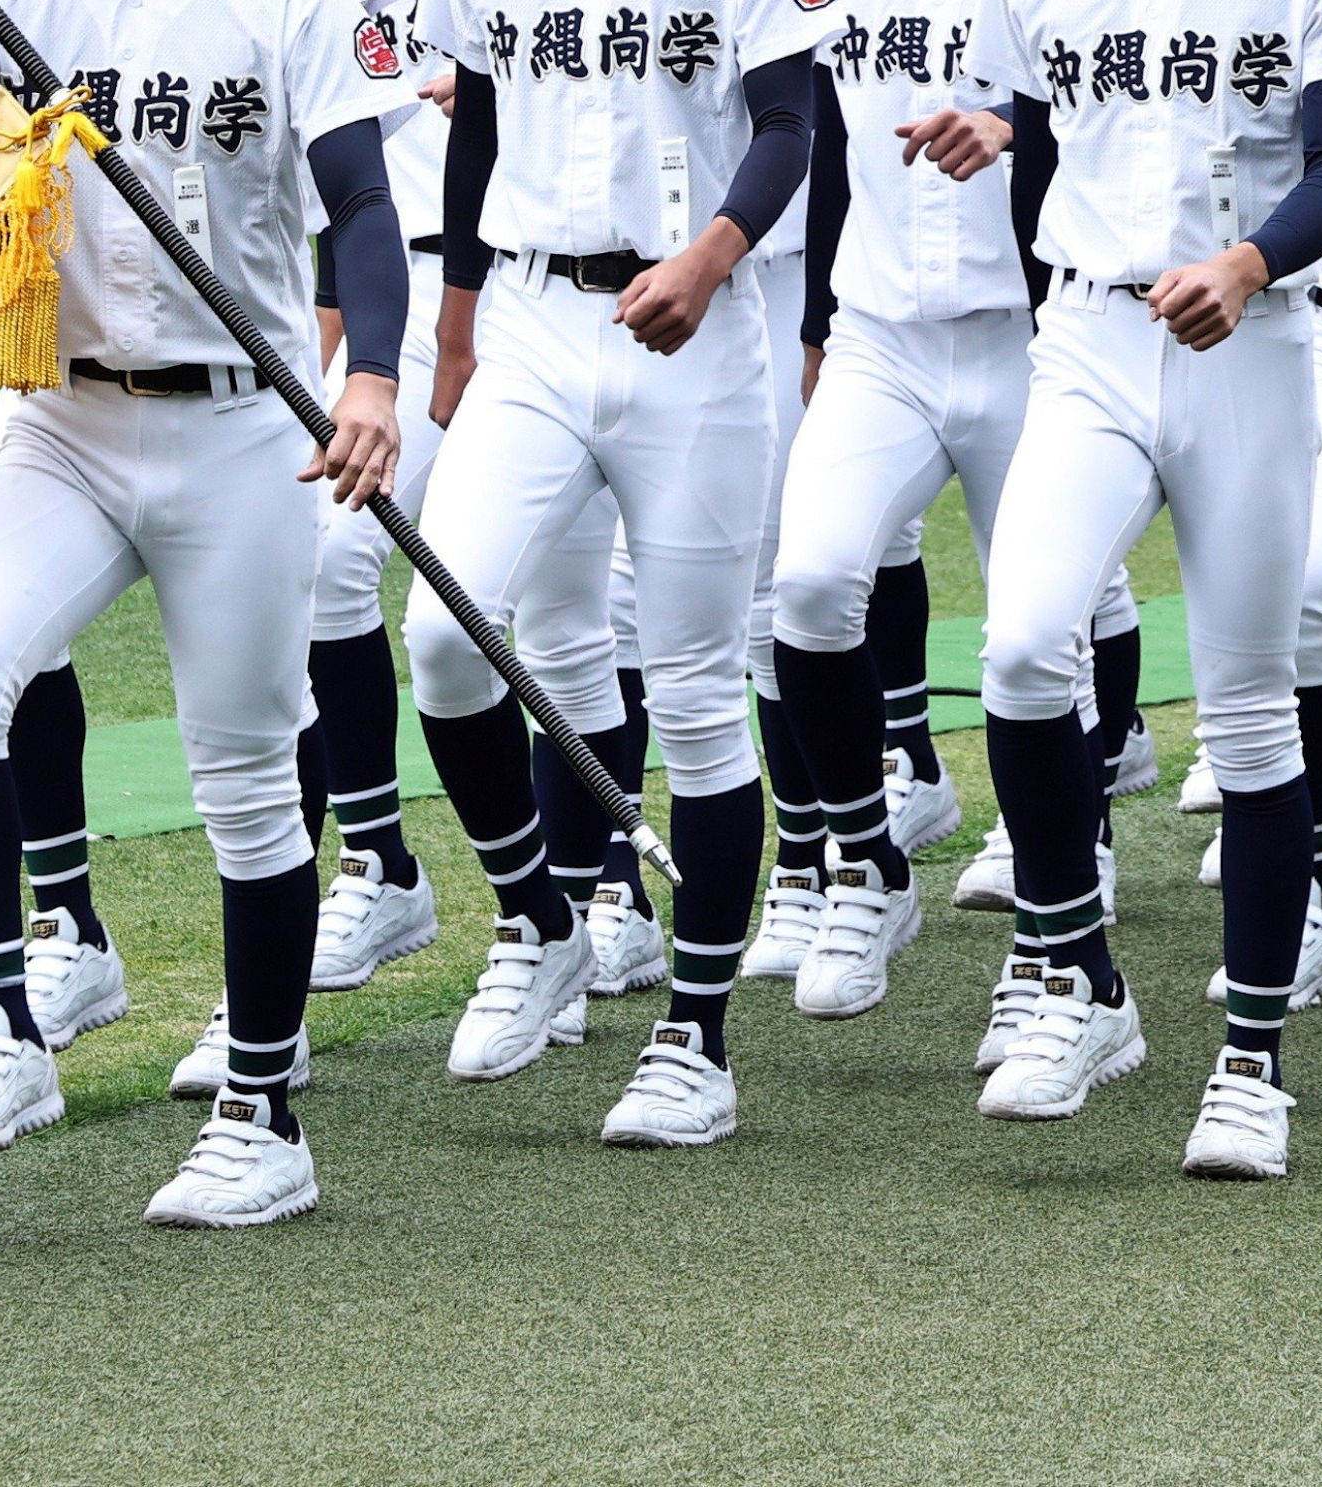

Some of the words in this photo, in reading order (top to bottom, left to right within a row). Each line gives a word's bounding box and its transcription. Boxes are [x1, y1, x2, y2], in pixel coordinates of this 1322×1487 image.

[486, 6, 720, 86] 沖縄尚学
[1042, 30, 1294, 110] 沖縄尚学
[658, 1033, 687, 1042] ZETT
[1229, 1062, 1262, 1072] ZETT
[221, 1102, 255, 1117] ZETT
